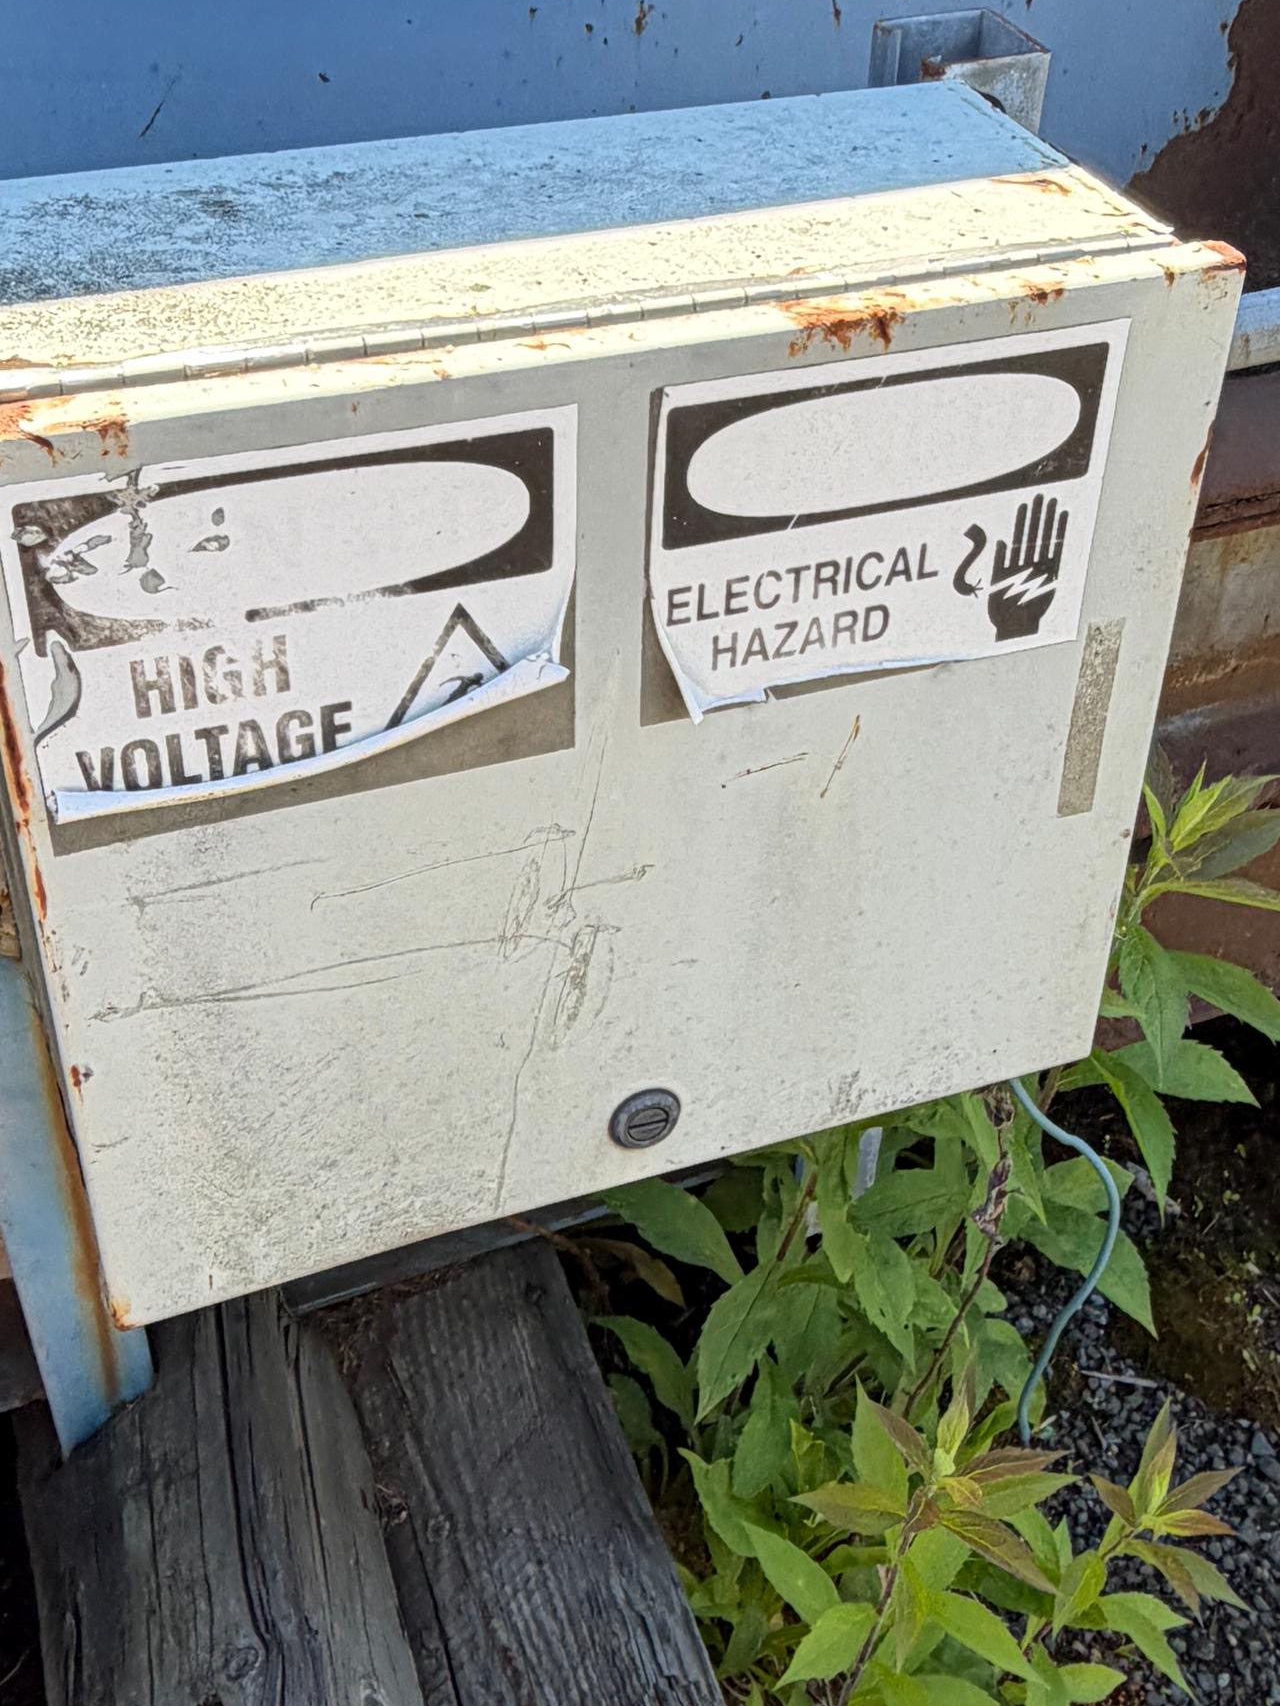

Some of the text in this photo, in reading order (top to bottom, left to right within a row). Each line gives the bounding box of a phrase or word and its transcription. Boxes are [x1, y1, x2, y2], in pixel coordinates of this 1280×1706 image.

[666, 543, 939, 626] ELECTRICAL
[129, 635, 290, 718] HIGH
[711, 604, 891, 671] HAZARD
[76, 701, 352, 791] VOLTAGE
